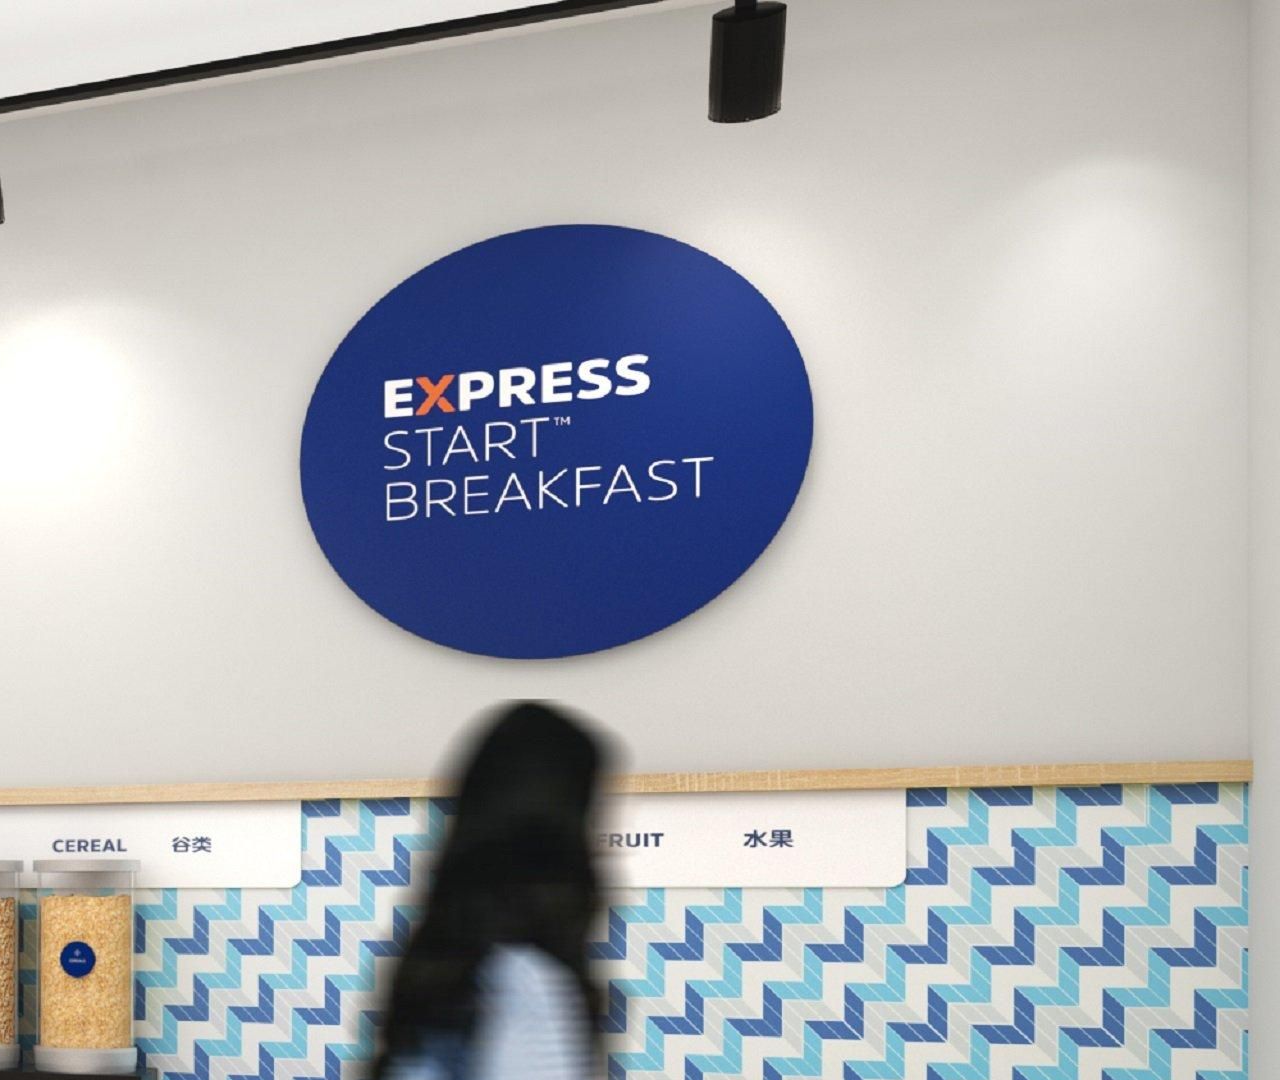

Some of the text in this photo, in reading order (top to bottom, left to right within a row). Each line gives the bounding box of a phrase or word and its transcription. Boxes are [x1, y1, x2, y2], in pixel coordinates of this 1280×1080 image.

[383, 353, 651, 419] EXPRESS
[385, 456, 715, 522] BREAKFAST
[51, 838, 128, 853] CEREAL
[171, 836, 212, 853] 谷类
[743, 829, 795, 849] 水果
